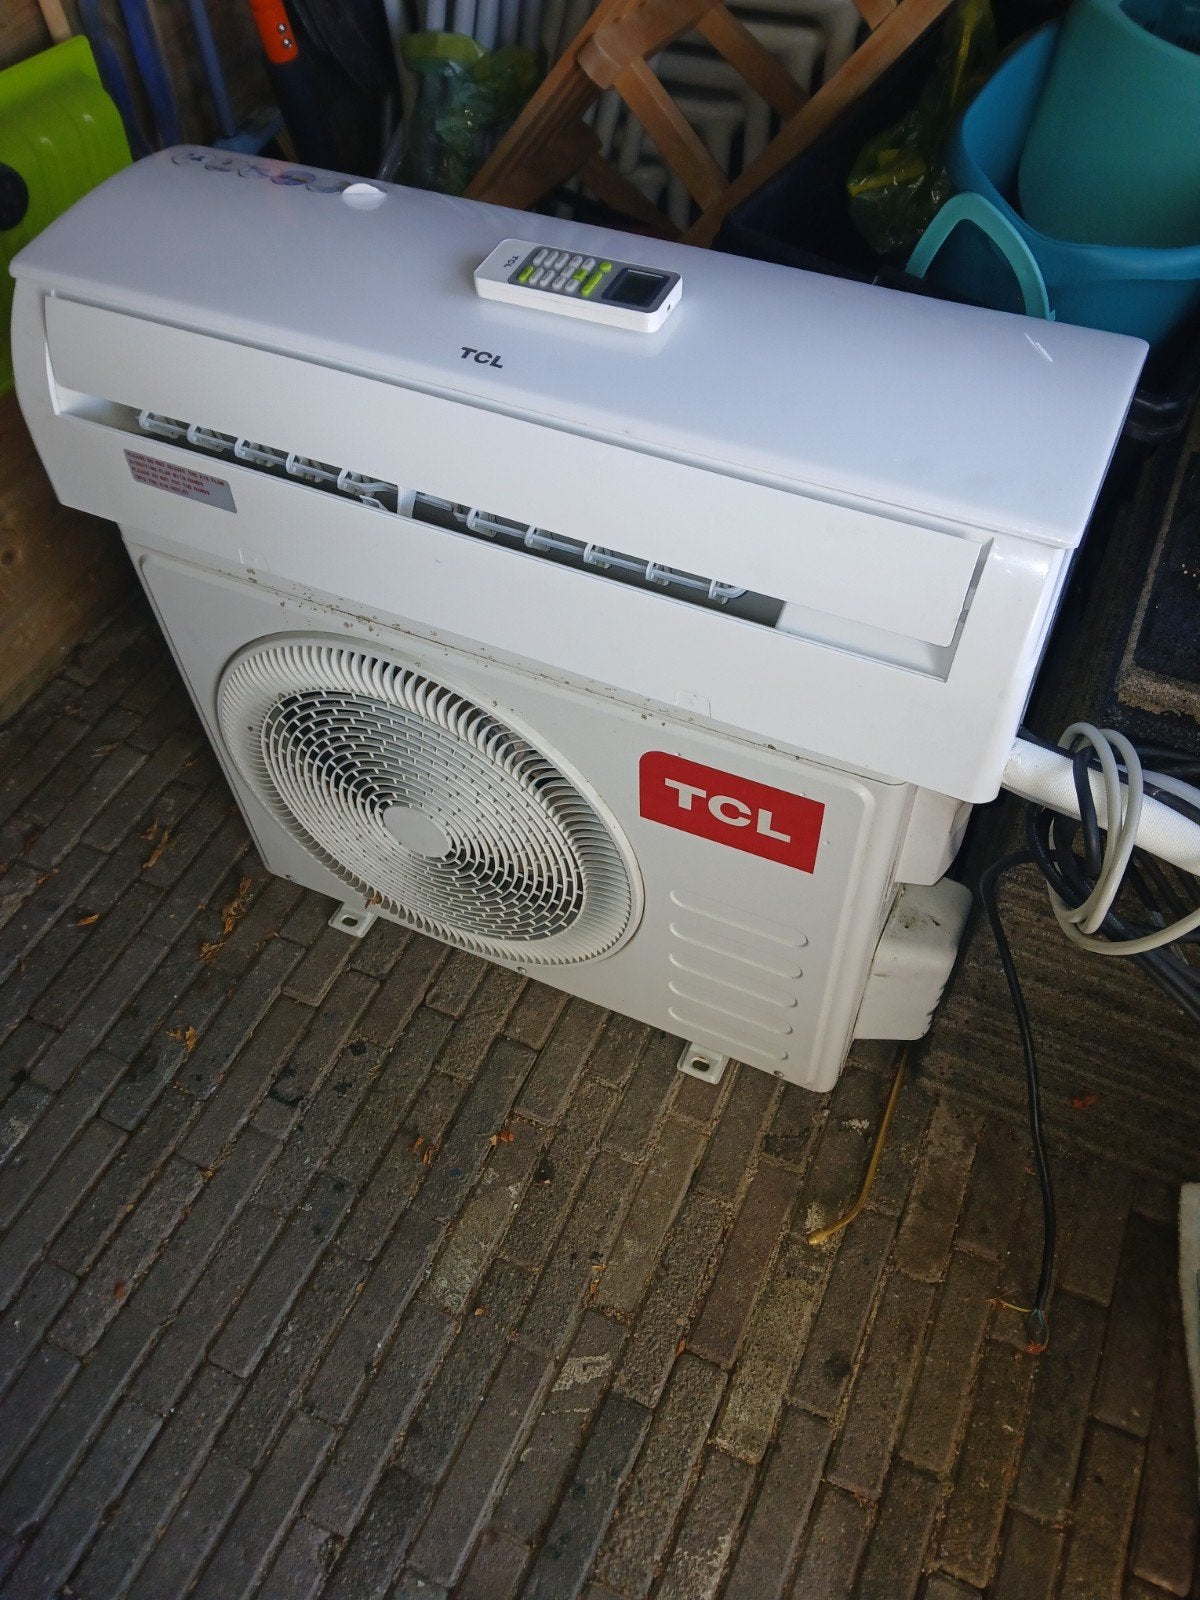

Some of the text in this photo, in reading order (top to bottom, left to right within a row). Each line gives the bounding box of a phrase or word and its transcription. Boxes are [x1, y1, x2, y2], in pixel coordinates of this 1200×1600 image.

[503, 255, 519, 268] TCL
[461, 346, 503, 369] TCL
[664, 777, 791, 843] TCL
